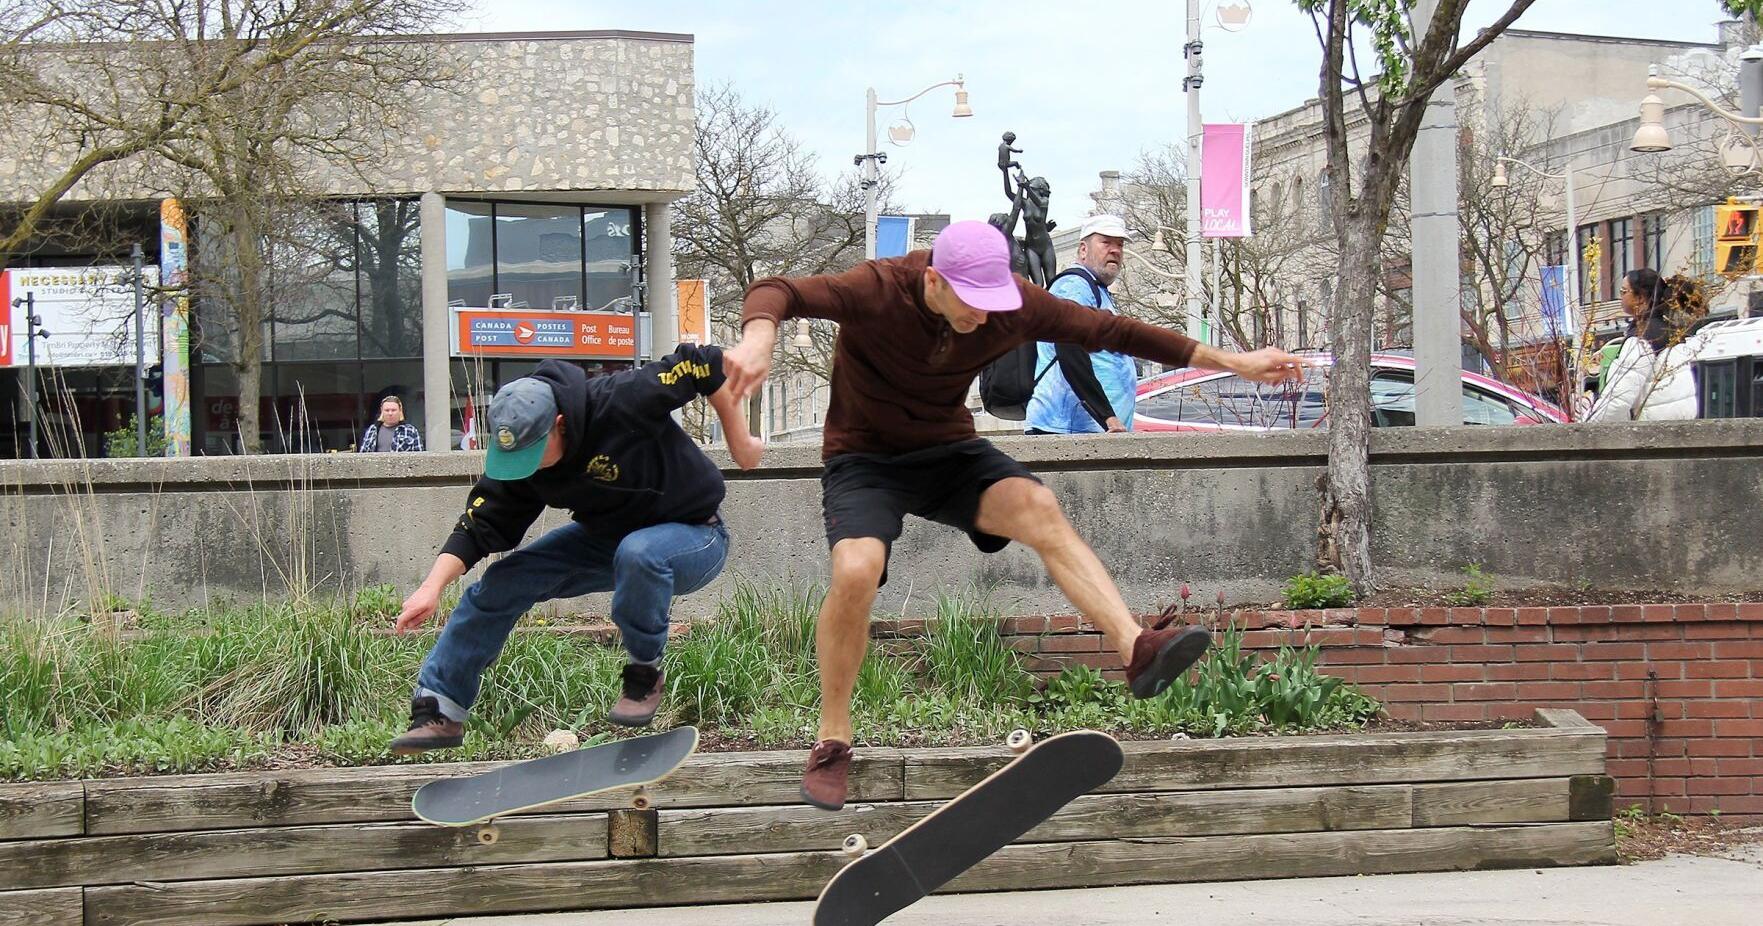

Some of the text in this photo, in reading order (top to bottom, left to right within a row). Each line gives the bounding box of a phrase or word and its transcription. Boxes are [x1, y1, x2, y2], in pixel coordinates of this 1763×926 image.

[1204, 208, 1230, 217] PLAY
[1203, 217, 1236, 230] LOCAL
[41, 287, 76, 295] STUDIO
[581, 323, 630, 334] Post Bureau
[581, 335, 635, 347] Office de poste
